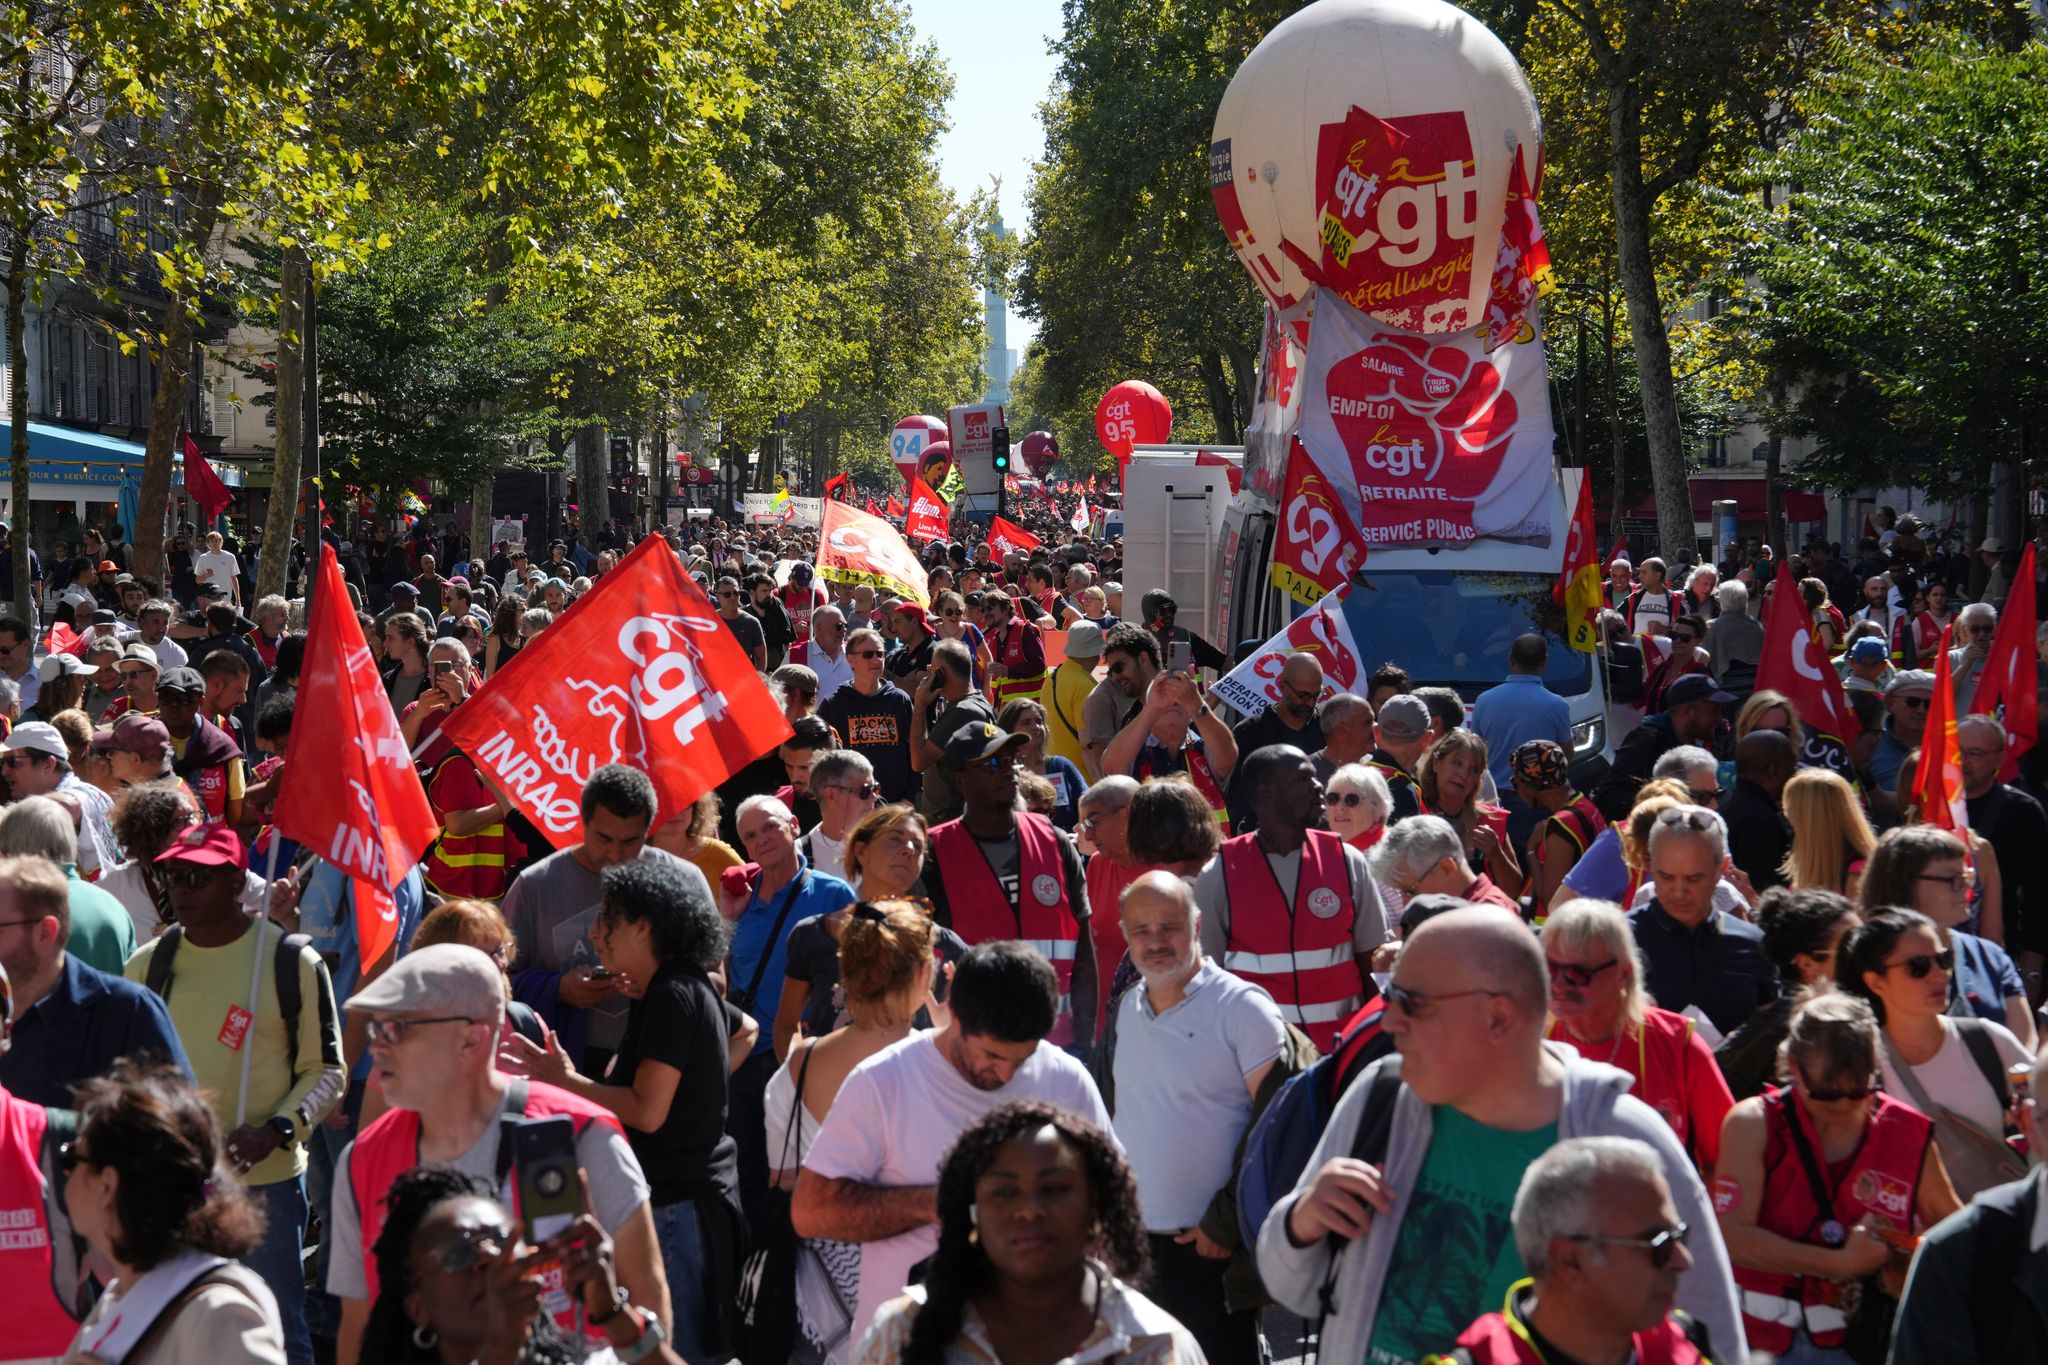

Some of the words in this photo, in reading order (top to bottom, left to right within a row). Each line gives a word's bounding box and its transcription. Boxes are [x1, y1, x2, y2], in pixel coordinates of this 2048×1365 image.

[1335, 165, 1380, 219] cgt
[1361, 356, 1405, 377] SALAIRE
[1427, 378, 1447, 386] TOUS
[1429, 384, 1451, 394] UNIS
[1106, 400, 1131, 420] cgt
[1329, 395, 1395, 420] EMPLOI
[966, 421, 990, 438] cgt
[1105, 420, 1136, 442] 95
[893, 434, 921, 458] 94
[1365, 439, 1426, 477] cgt
[63, 473, 98, 481] SERVICE
[1360, 485, 1448, 502] RETRAITE
[1362, 520, 1423, 543] SERVICE
[1426, 519, 1476, 540] PUBLIC
[618, 616, 728, 746] cgt
[1877, 1190, 1908, 1213] cgt
